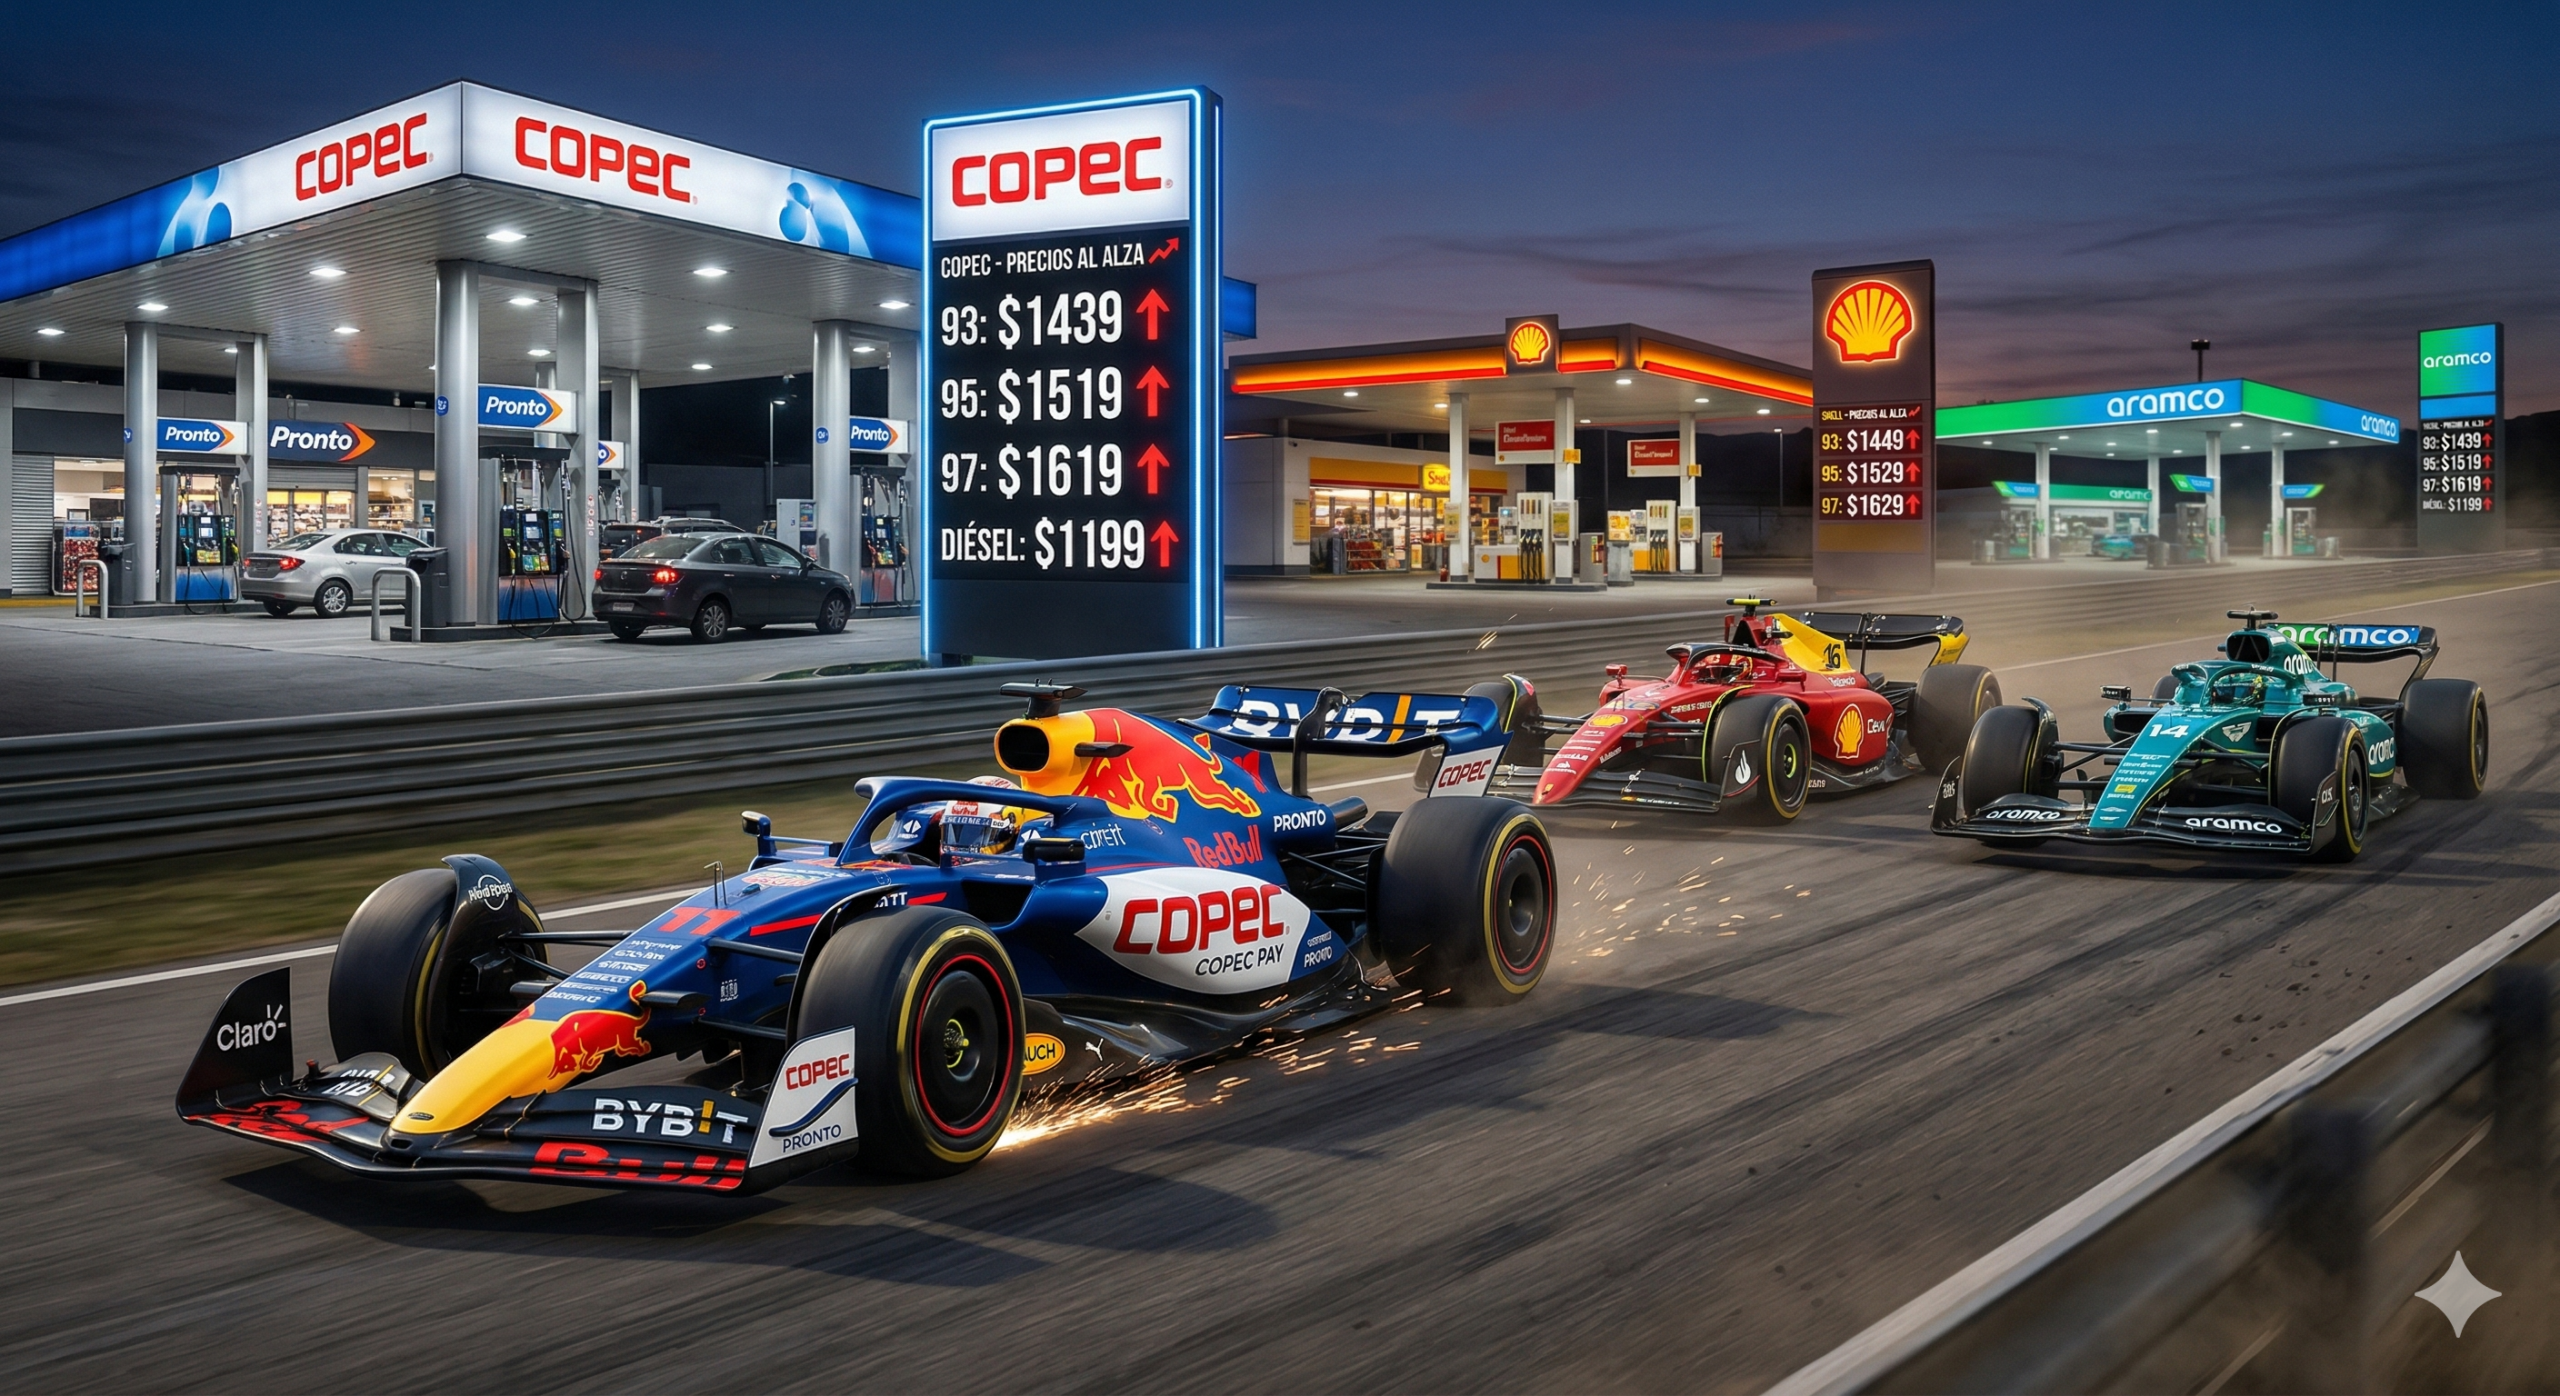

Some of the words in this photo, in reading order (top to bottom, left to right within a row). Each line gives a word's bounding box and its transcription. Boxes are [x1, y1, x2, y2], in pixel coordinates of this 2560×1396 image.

[296, 112, 427, 201] COPEC
[515, 116, 690, 203] COPEC
[952, 136, 1162, 207] COPEC
[941, 254, 991, 278] COPEC
[1006, 248, 1073, 274] PRECIOS
[1077, 247, 1098, 269] AL
[1102, 243, 1145, 267] ALZA
[941, 305, 987, 346] 93:
[998, 290, 1123, 350] $1439
[2423, 351, 2492, 368] aramco
[485, 396, 547, 416] Pronto
[941, 378, 987, 419] 95:
[998, 366, 1122, 425] $1519
[2106, 388, 2225, 417] aramco
[165, 426, 221, 443] Pronto
[270, 426, 353, 450] Pronto
[851, 426, 889, 441] Pronto
[2361, 414, 2397, 438] aramco
[1821, 433, 1843, 450] 93:
[1846, 429, 1904, 453] $1449
[2422, 436, 2440, 450] 93:
[2441, 432, 2482, 451] $1439
[941, 453, 987, 493] 97:
[998, 443, 1122, 499] $1619
[1821, 465, 1843, 482] 95:
[1846, 461, 1904, 485] $1529
[2422, 457, 2440, 471] 95:
[2441, 453, 2482, 472] $1519
[2422, 478, 2440, 492] 97:
[2441, 475, 2482, 493] $1619
[1821, 497, 1843, 514] 97:
[1846, 493, 1904, 517] $1629
[2447, 496, 2482, 512] $1199
[941, 520, 1026, 562] DIÉSEL:
[1034, 516, 1146, 570] $1199
[1823, 643, 1841, 669] 16
[2149, 724, 2189, 738] 14
[1437, 759, 1492, 788] COPEC
[1273, 809, 1327, 832] PRONTO
[1986, 810, 2061, 820] aramco
[2185, 818, 2283, 834] aramco
[657, 906, 741, 936] 11
[1113, 884, 1285, 955] COPEC
[1195, 951, 1254, 976] COPEC
[1256, 943, 1285, 967] PAY
[216, 1013, 280, 1051] Claro
[1024, 1042, 1056, 1062] UCH
[785, 1053, 850, 1090] COPEC
[782, 1124, 842, 1153] PRONTO
